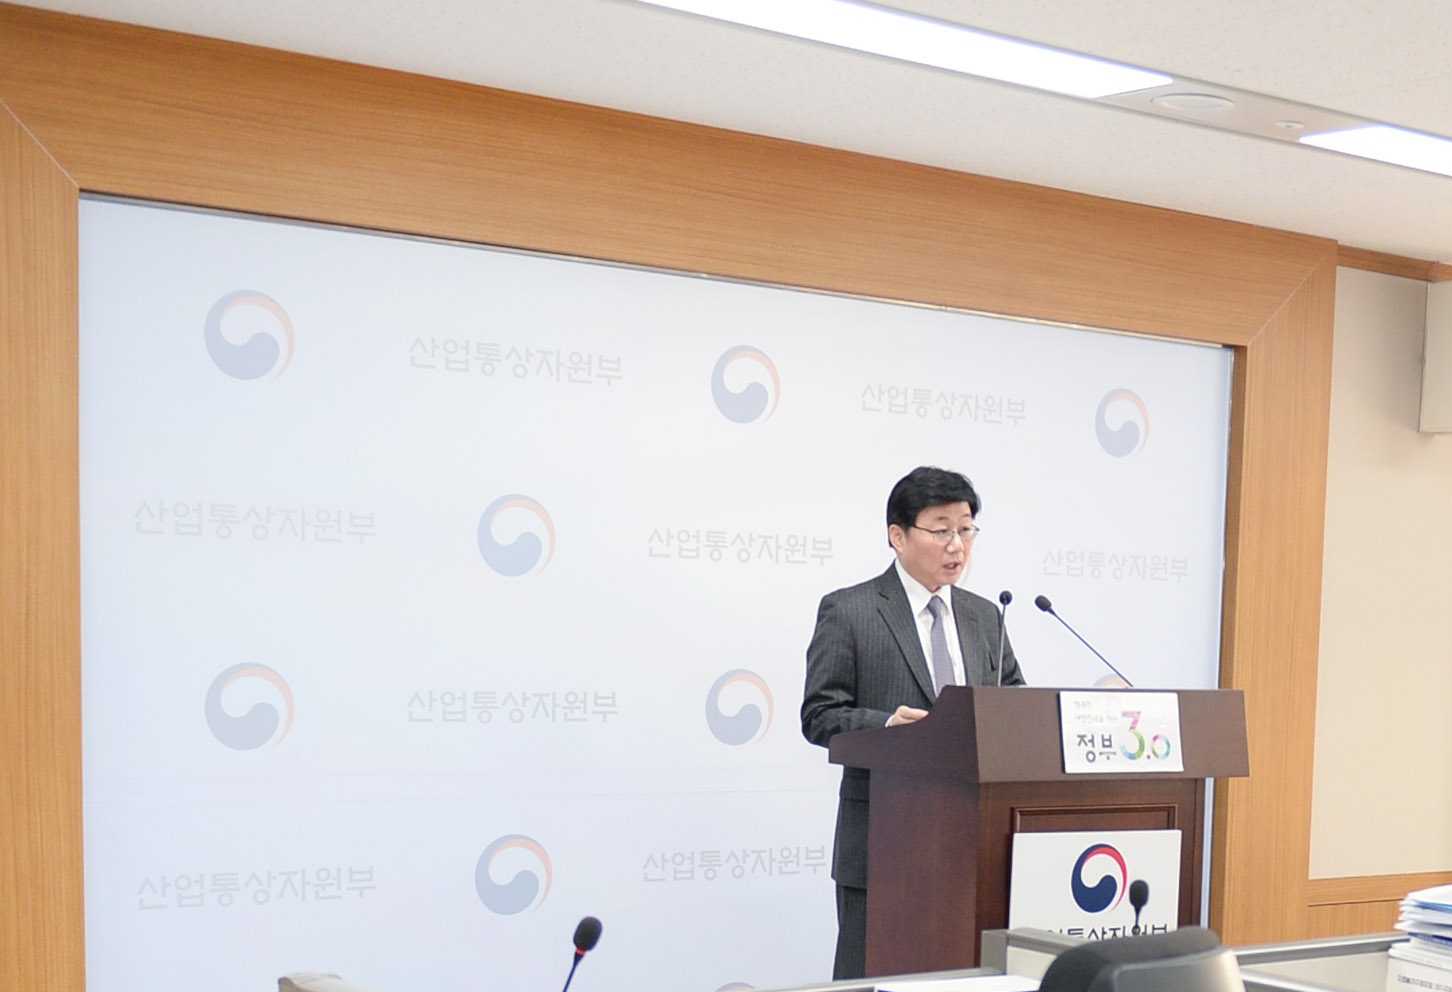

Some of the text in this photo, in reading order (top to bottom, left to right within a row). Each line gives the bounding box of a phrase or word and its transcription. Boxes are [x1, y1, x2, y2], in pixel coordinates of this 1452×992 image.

[408, 335, 624, 387] 산업통상자원부
[860, 382, 1027, 427] 산업통상자원부
[133, 499, 378, 545] 산업통상자원부
[647, 526, 835, 567] 산업통상자원부
[1042, 549, 1190, 583] 산업통상자원부
[407, 690, 618, 725] 산업통상자원부
[1077, 733, 1117, 764] 정부
[642, 845, 828, 884] 산업통상자원부
[137, 865, 376, 911] 산업통상자원부
